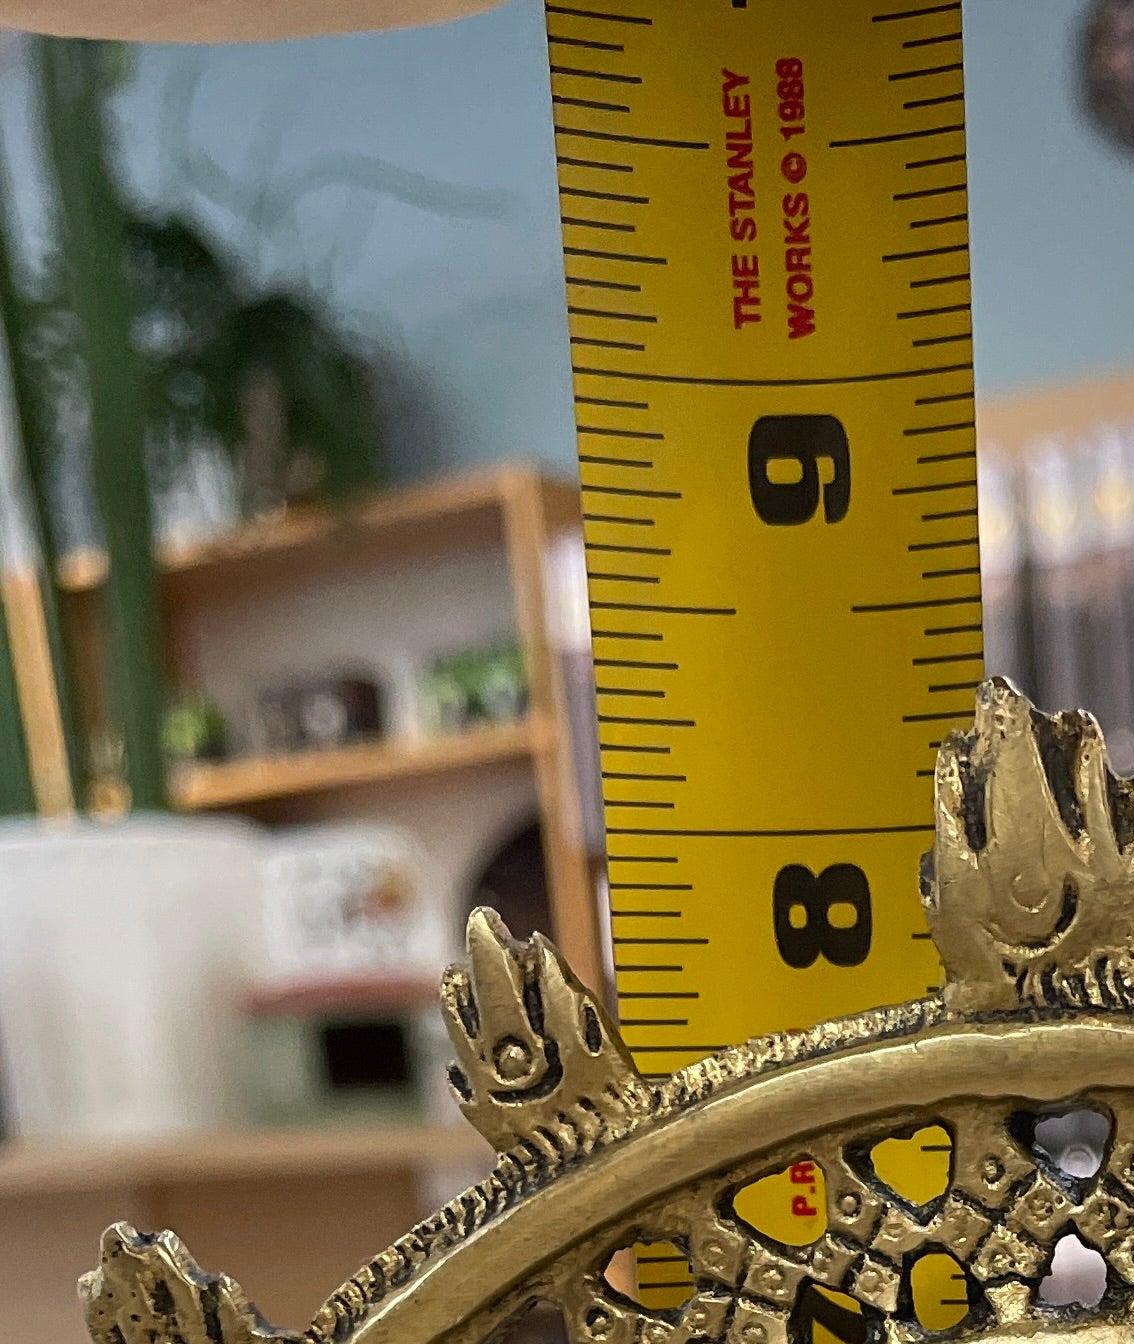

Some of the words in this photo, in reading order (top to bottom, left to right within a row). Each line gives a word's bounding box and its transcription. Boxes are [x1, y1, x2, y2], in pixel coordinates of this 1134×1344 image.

[721, 67, 757, 242] STANLEY
[775, 56, 806, 142] 1988
[731, 255, 762, 330] THE
[782, 192, 816, 339] WORKS
[746, 413, 852, 527] 9
[772, 862, 873, 970] 8
